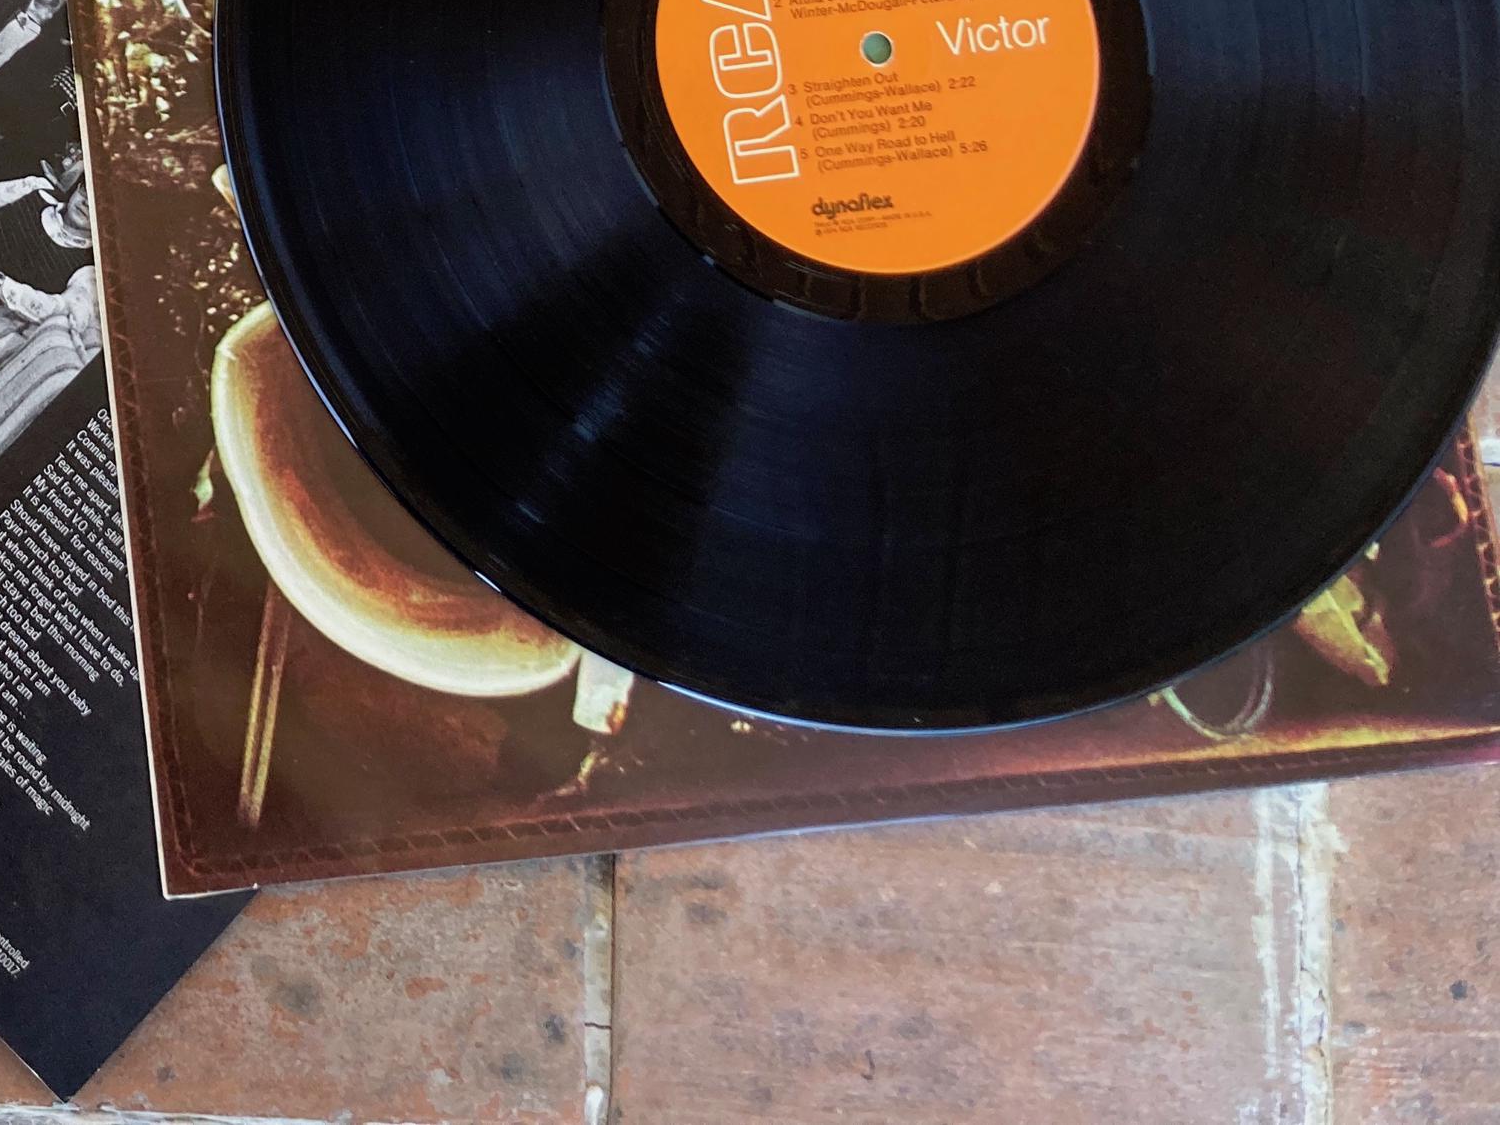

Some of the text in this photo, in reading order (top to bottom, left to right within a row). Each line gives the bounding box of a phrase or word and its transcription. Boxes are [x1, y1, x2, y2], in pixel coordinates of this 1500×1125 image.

[936, 15, 1051, 56] Victor
[810, 188, 895, 221] dynaflex
[0, 509, 83, 596] Payin' much too bad
[9, 498, 135, 625] Should have stayed in bed this
[22, 484, 113, 583] It is pleasin' for reason.
[2, 579, 22, 600] stay
[20, 596, 31, 610] in
[29, 605, 50, 627] bed
[46, 623, 64, 644] this
[63, 642, 99, 682] morning
[6, 719, 16, 733] is
[15, 729, 46, 766] waiting
